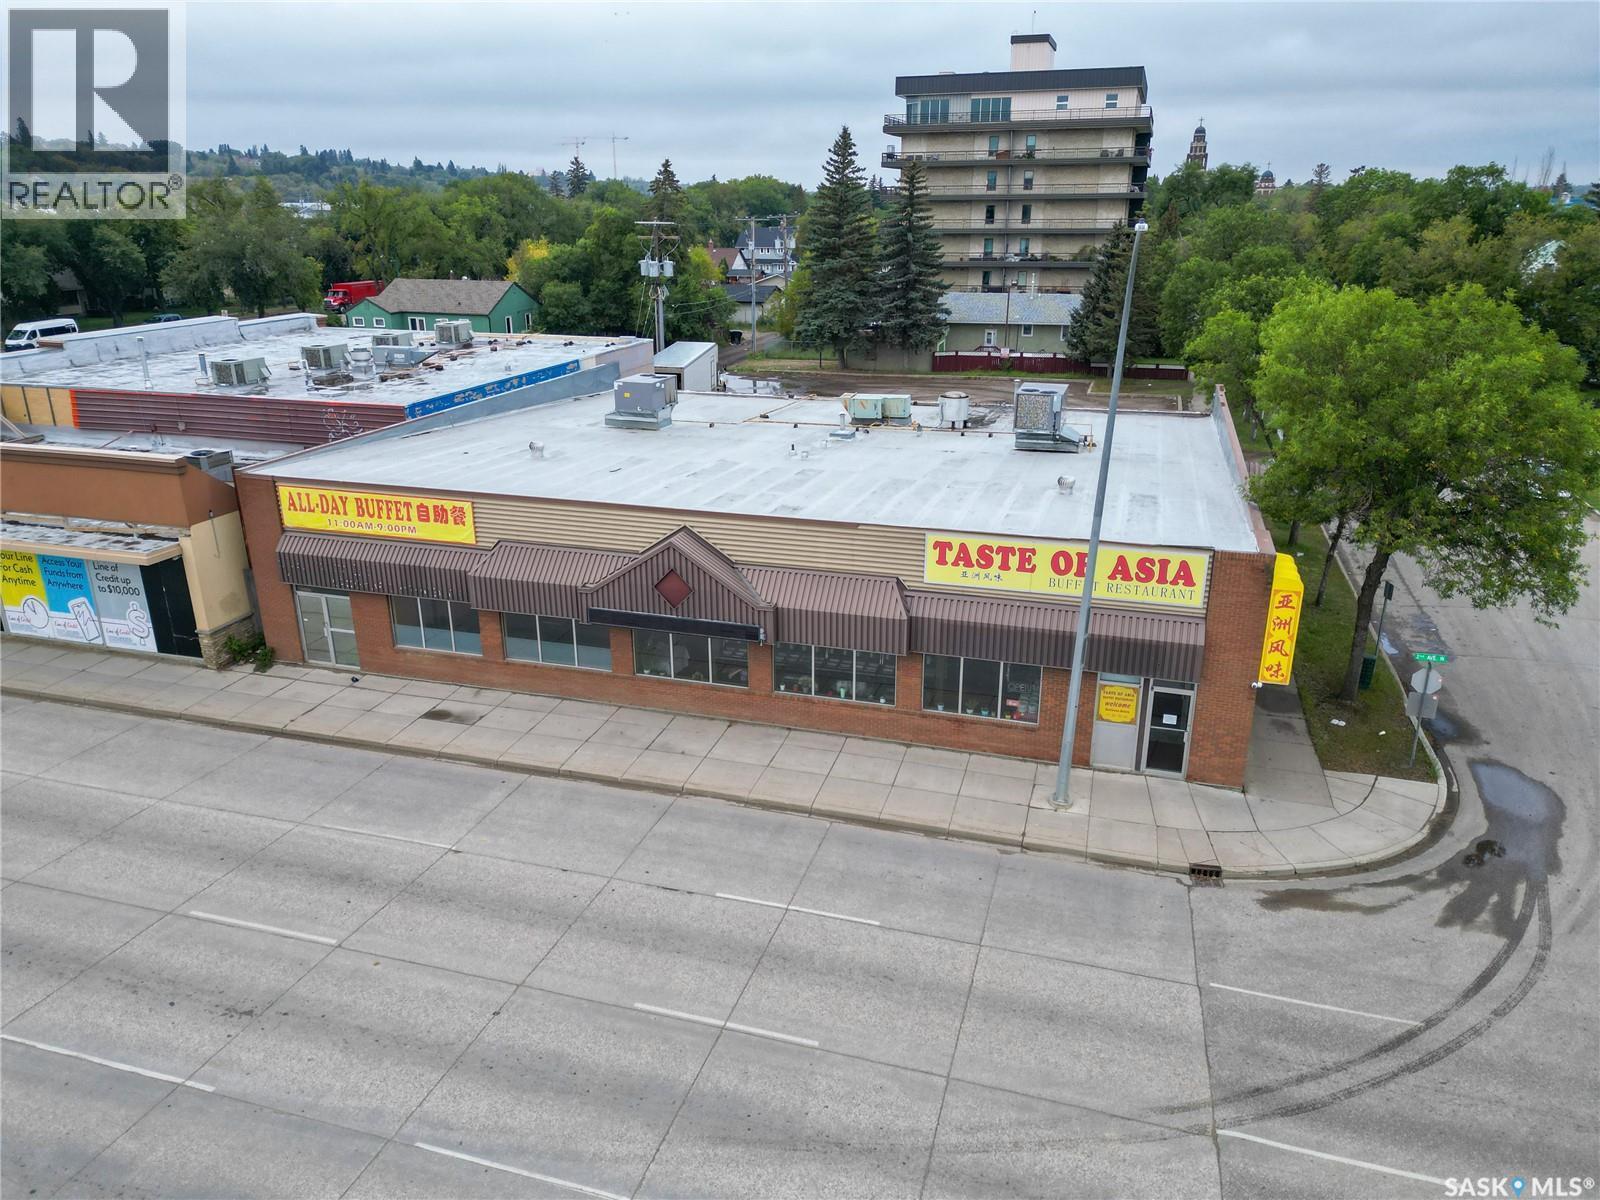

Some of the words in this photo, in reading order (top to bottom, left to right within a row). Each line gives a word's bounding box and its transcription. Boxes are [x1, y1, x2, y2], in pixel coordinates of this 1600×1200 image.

[288, 491, 349, 516] ALL-DAY
[355, 497, 413, 522] BUFFET
[416, 502, 467, 527] 自助餐
[15, 552, 33, 562] Line
[41, 557, 65, 567] Access
[67, 558, 82, 568] Your
[13, 563, 33, 574] Cash
[92, 560, 109, 571] Line
[110, 563, 119, 572] of
[933, 541, 1037, 574] TASTE
[1107, 555, 1196, 587] ASIA
[44, 567, 65, 577] Funds
[66, 569, 83, 579] from
[2, 575, 36, 587] Anytime
[47, 579, 84, 590] Anywhere
[95, 572, 119, 583] Credit
[120, 577, 131, 587] up
[107, 584, 140, 596] $10,000
[1048, 577, 1099, 591] BUFFT
[1107, 582, 1196, 600] RESTAURANT
[1264, 594, 1296, 679] 亚洲风味
